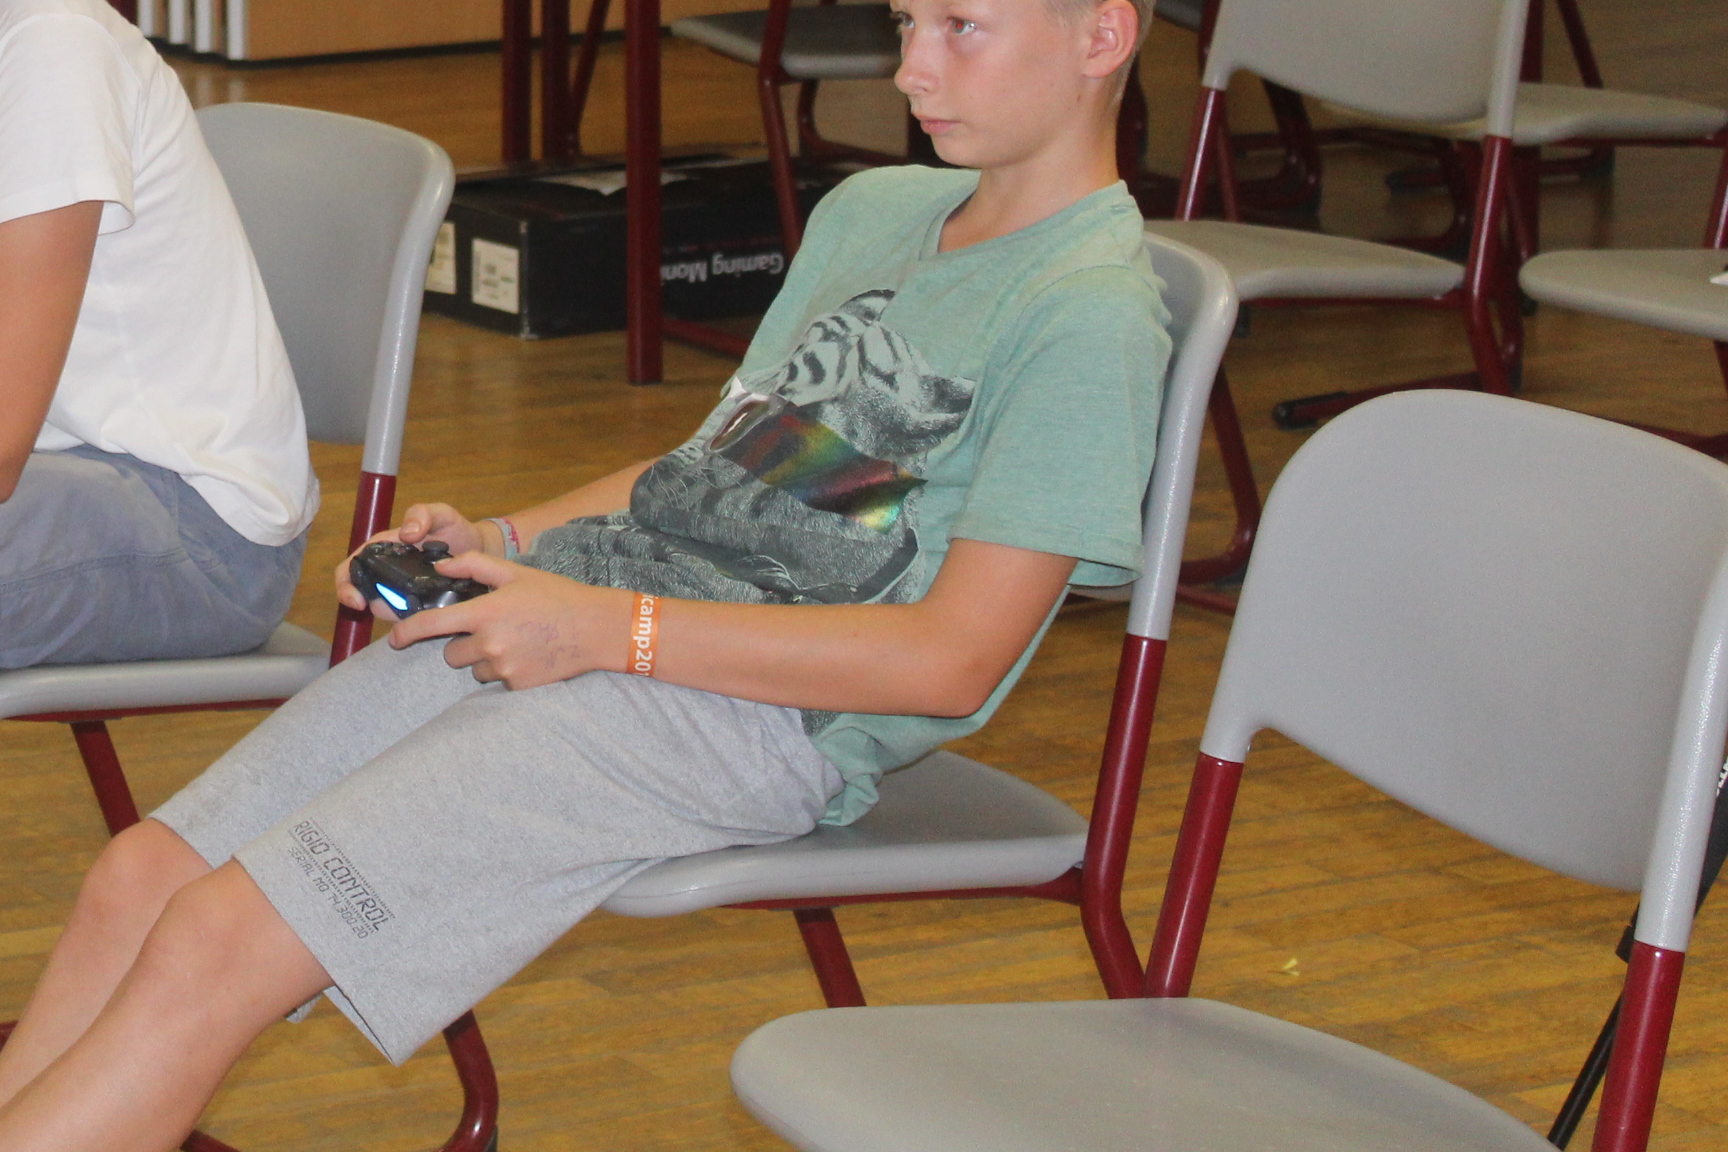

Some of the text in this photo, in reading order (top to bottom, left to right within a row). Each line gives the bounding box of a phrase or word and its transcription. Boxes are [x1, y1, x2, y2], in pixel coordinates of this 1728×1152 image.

[712, 253, 783, 278] Gaming
[287, 846, 315, 877] SERIAL
[293, 820, 389, 932] RIGID CONTROL
